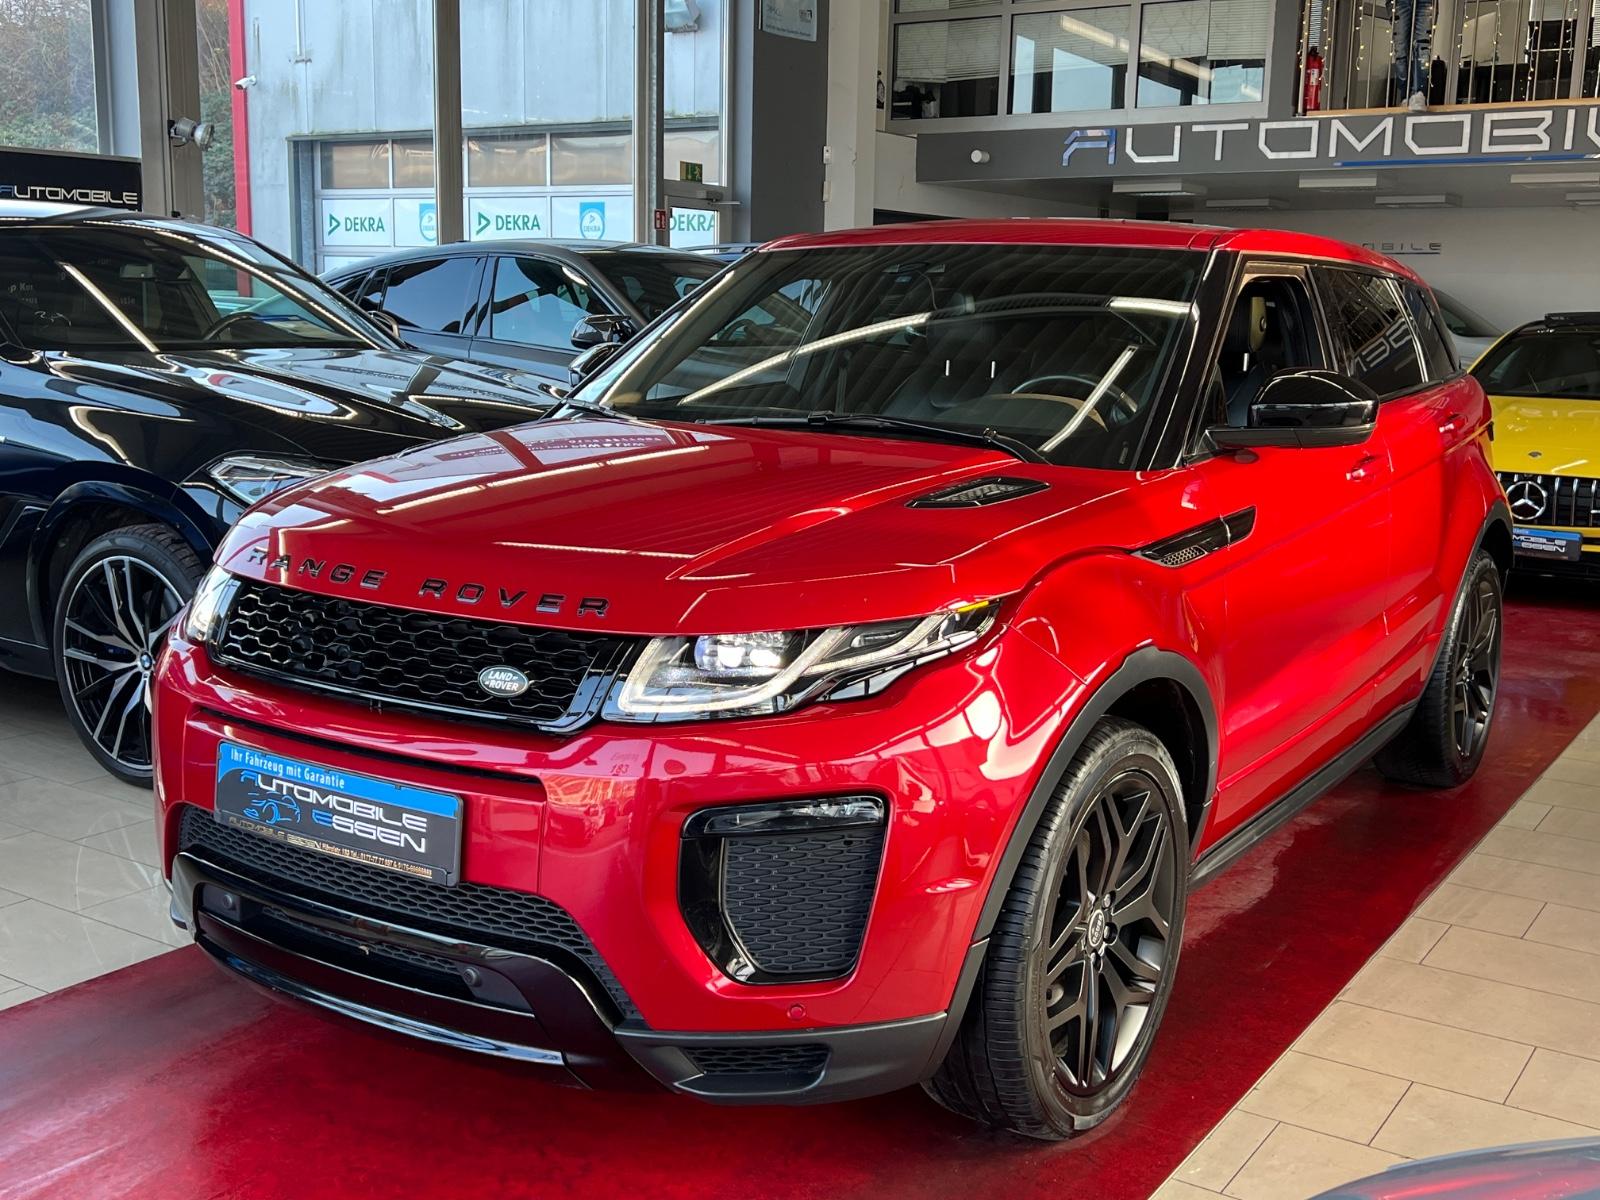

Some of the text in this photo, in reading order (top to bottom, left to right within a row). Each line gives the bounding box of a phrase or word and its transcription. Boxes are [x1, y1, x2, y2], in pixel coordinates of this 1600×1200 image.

[0, 185, 138, 204] AUTOMOBILE
[345, 217, 385, 232] DEKRA
[496, 215, 541, 231] DEKRA
[248, 547, 610, 617] RANGE ROVER
[488, 671, 513, 680] LAND
[489, 680, 519, 691] ROVER
[231, 748, 345, 788] Ihr Fahrzeug mit Garantie
[241, 770, 427, 832] AUTOMOBILE
[312, 810, 426, 853] ESSEN
